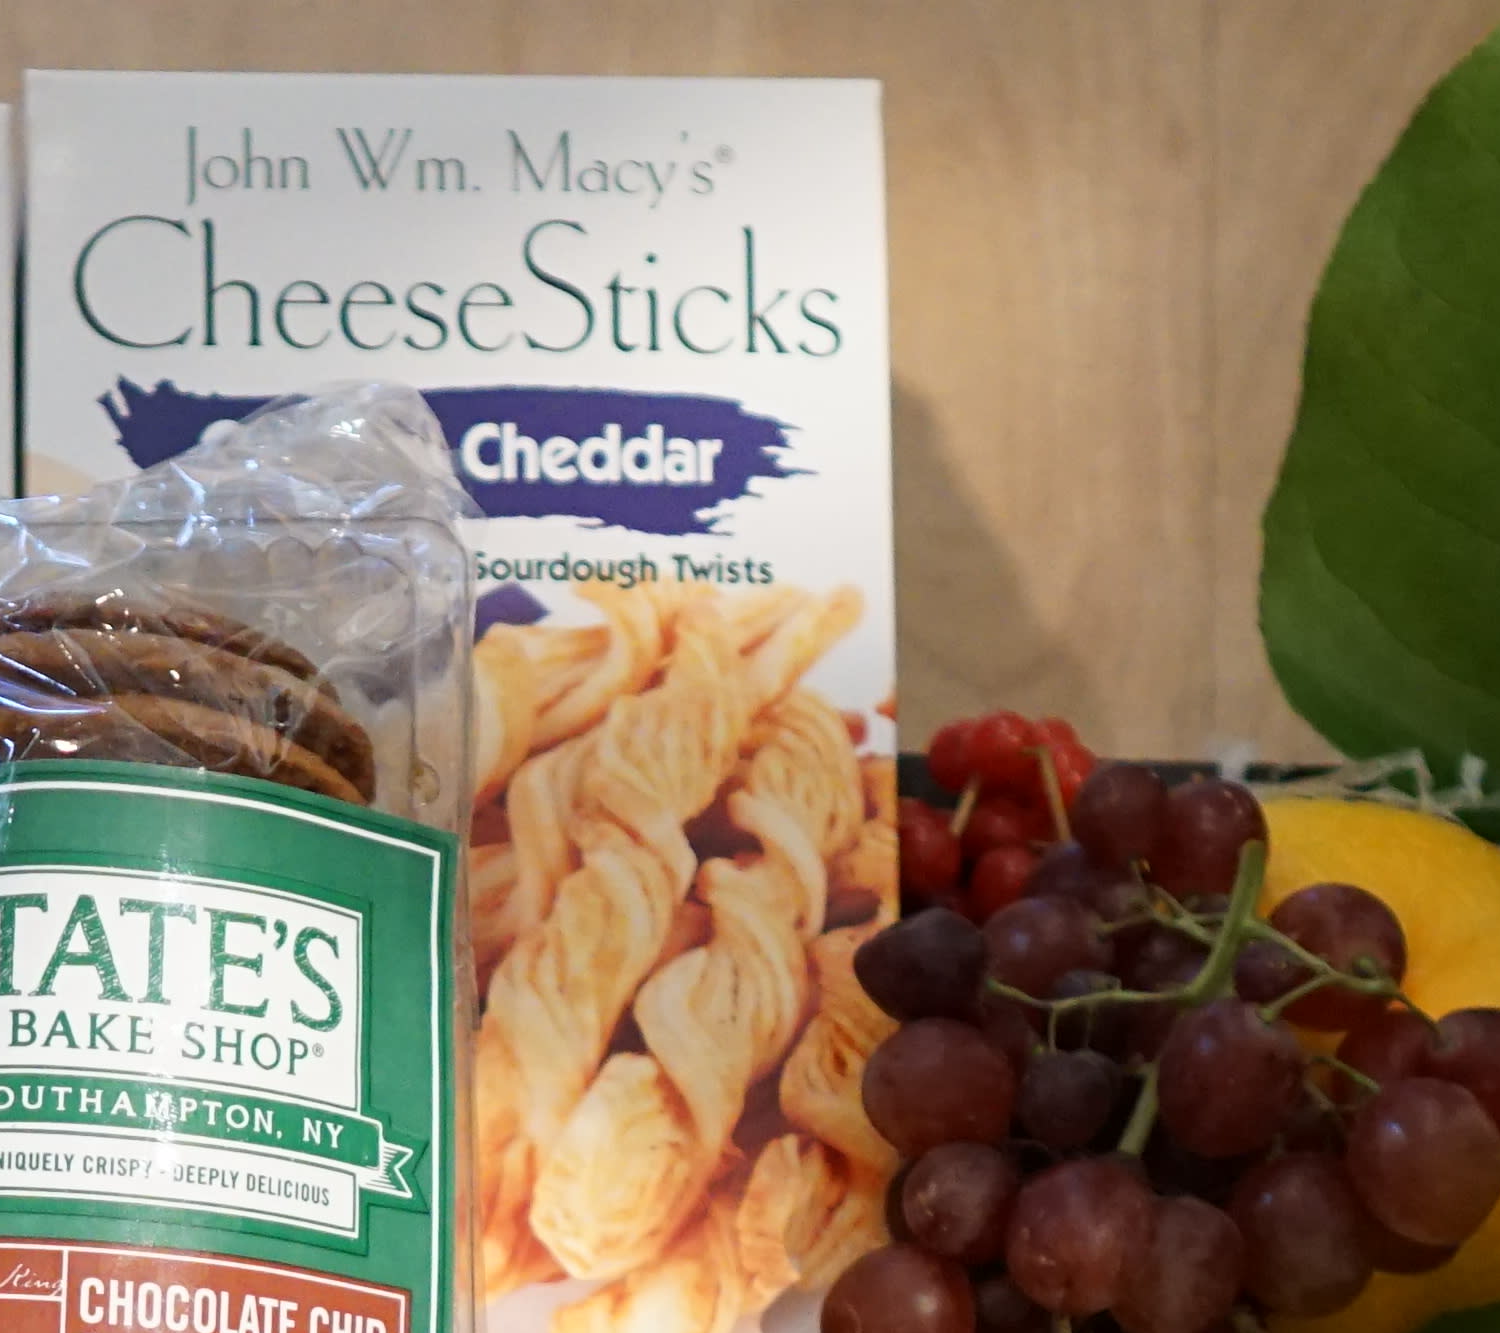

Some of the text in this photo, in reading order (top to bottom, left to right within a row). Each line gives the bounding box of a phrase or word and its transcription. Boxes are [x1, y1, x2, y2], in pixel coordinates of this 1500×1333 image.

[185, 126, 310, 206] John
[335, 126, 481, 193] Wm.
[72, 214, 844, 357] CheeseSticks
[460, 421, 723, 487] Cheddar
[475, 551, 775, 590] Sourdough Twists
[8, 1009, 155, 1056] BAKE
[303, 1116, 344, 1149] NY
[83, 1155, 151, 1180] CRISPY
[174, 1163, 239, 1190] DEEPLY
[246, 1174, 330, 1207] DELICIOUS
